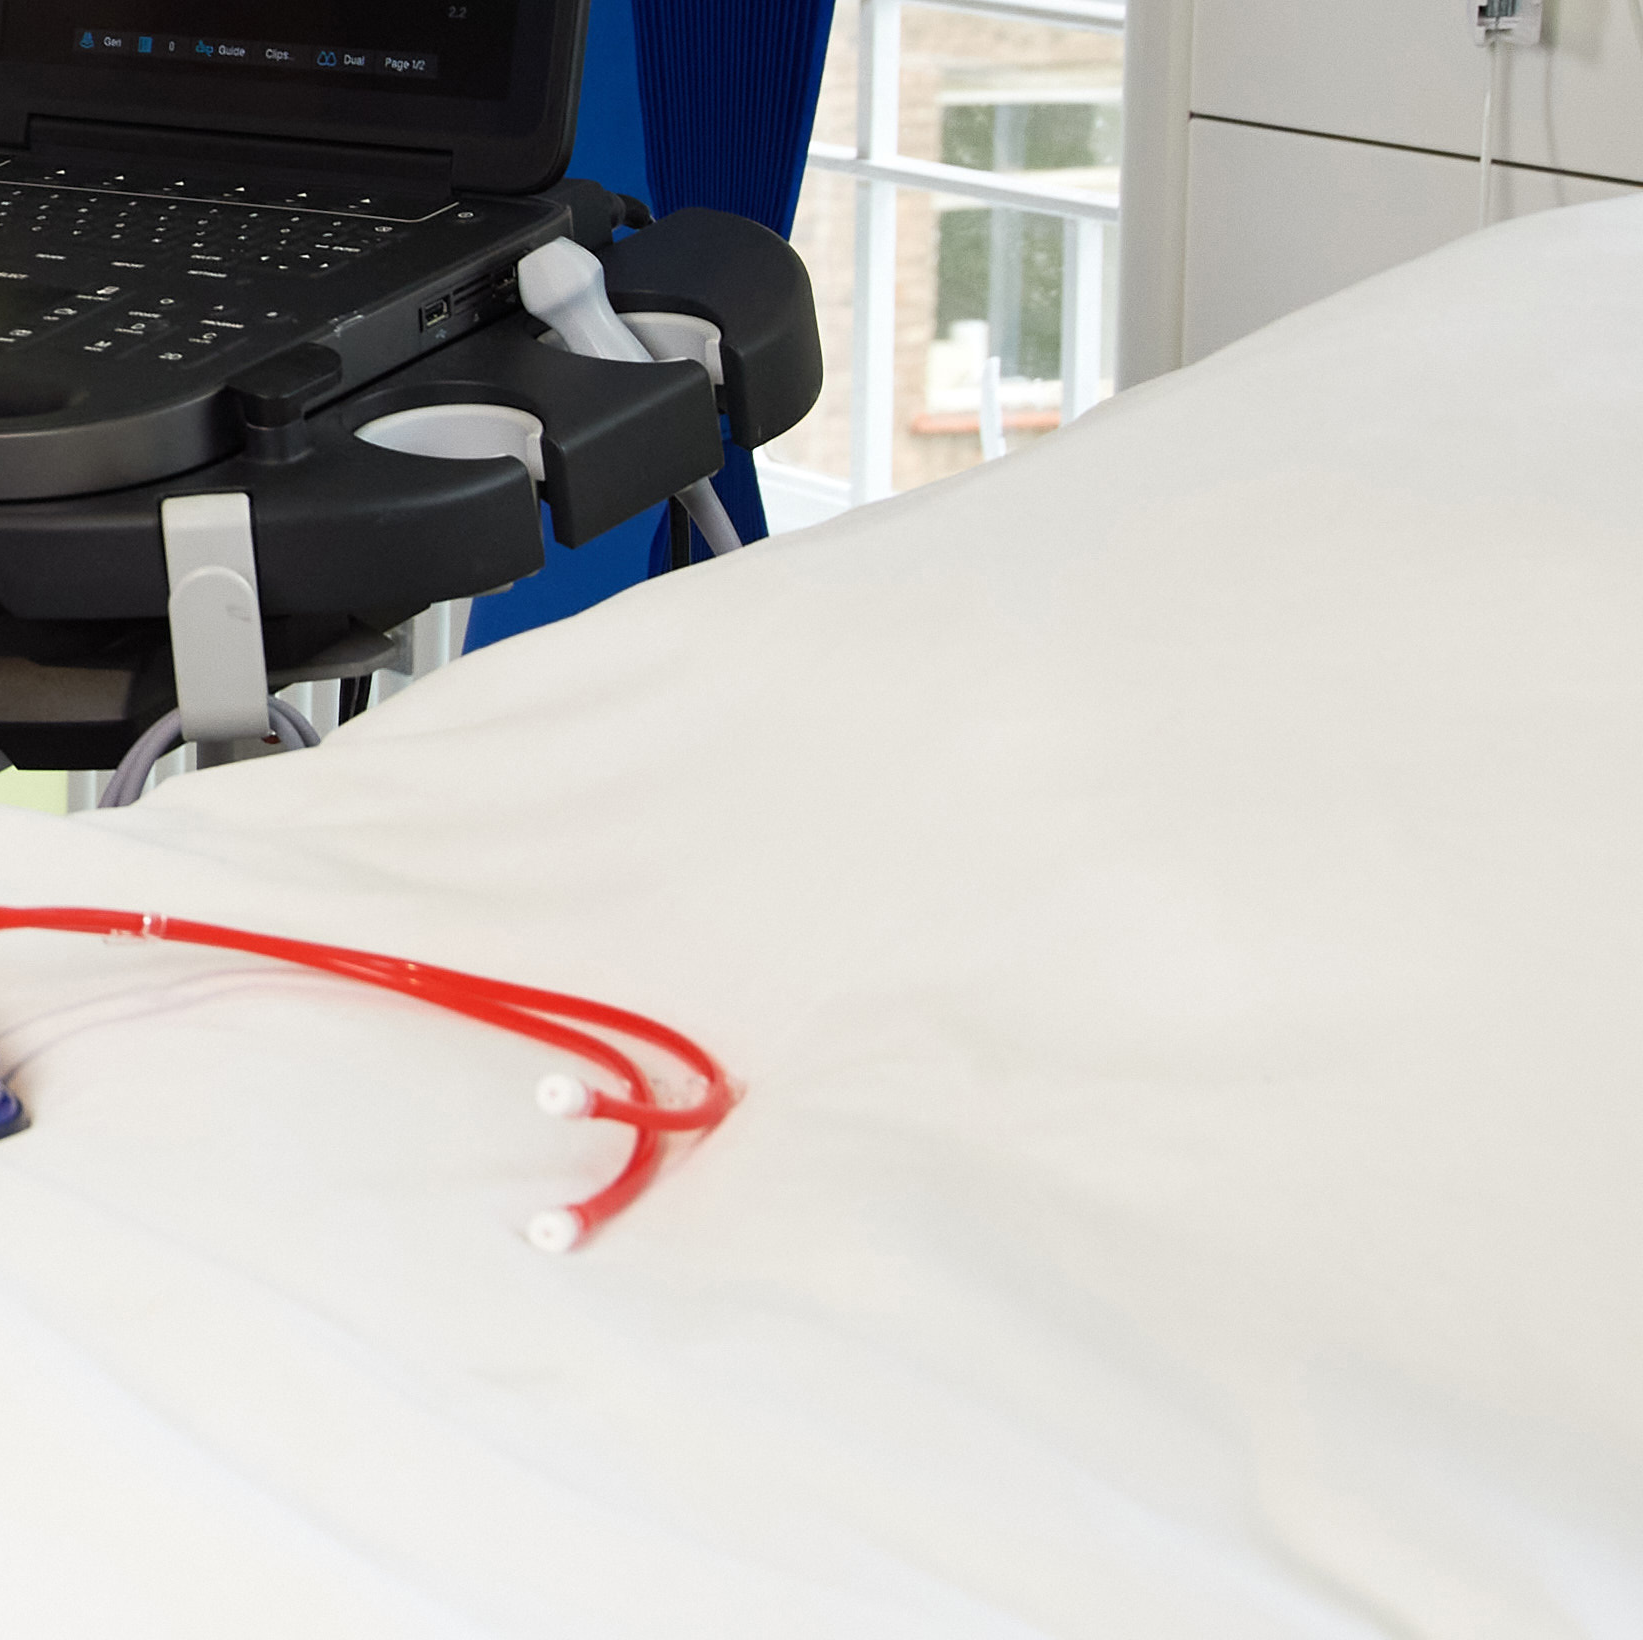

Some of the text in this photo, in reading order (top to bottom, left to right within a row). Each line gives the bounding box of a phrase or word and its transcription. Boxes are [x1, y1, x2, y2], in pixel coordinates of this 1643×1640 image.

[448, 5, 467, 19] 2.2
[218, 44, 246, 57] Guide
[344, 54, 365, 66] Dual
[384, 57, 410, 72] Page
